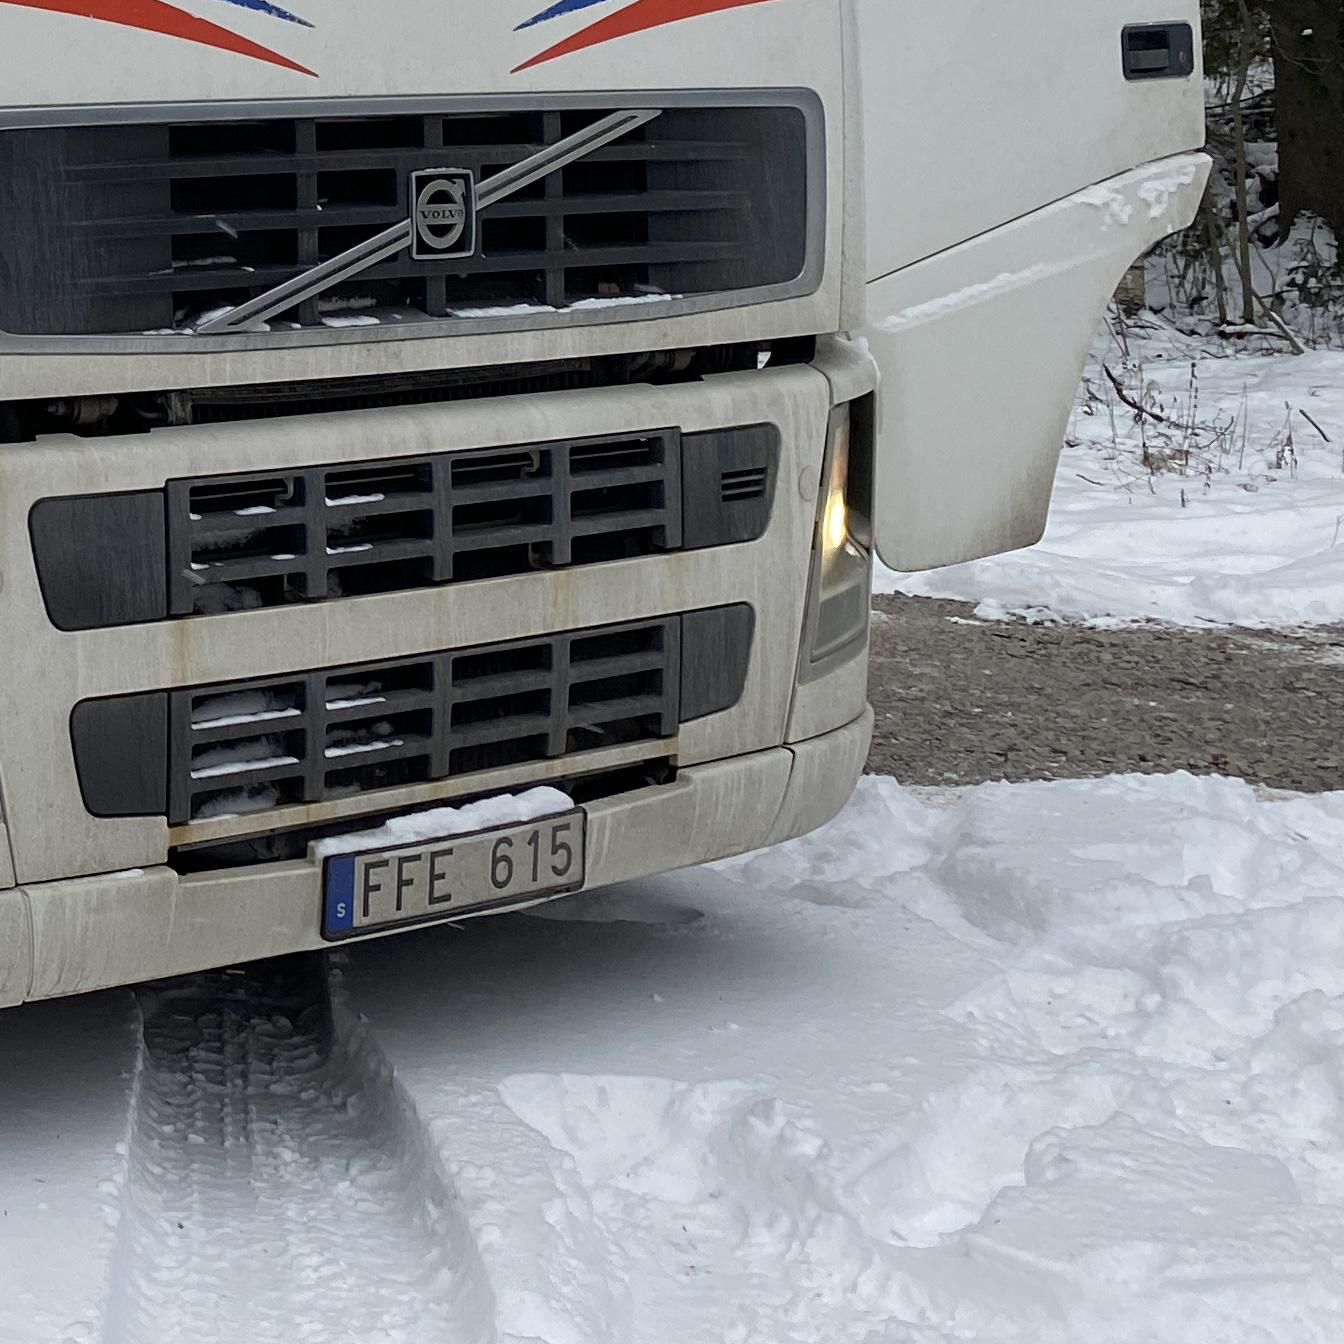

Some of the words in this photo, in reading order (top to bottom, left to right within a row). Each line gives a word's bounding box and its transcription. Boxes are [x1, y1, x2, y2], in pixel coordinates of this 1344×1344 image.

[419, 208, 464, 220] VOLVO
[363, 848, 453, 917] FFE
[491, 822, 572, 889] 615
[337, 903, 346, 918] S
